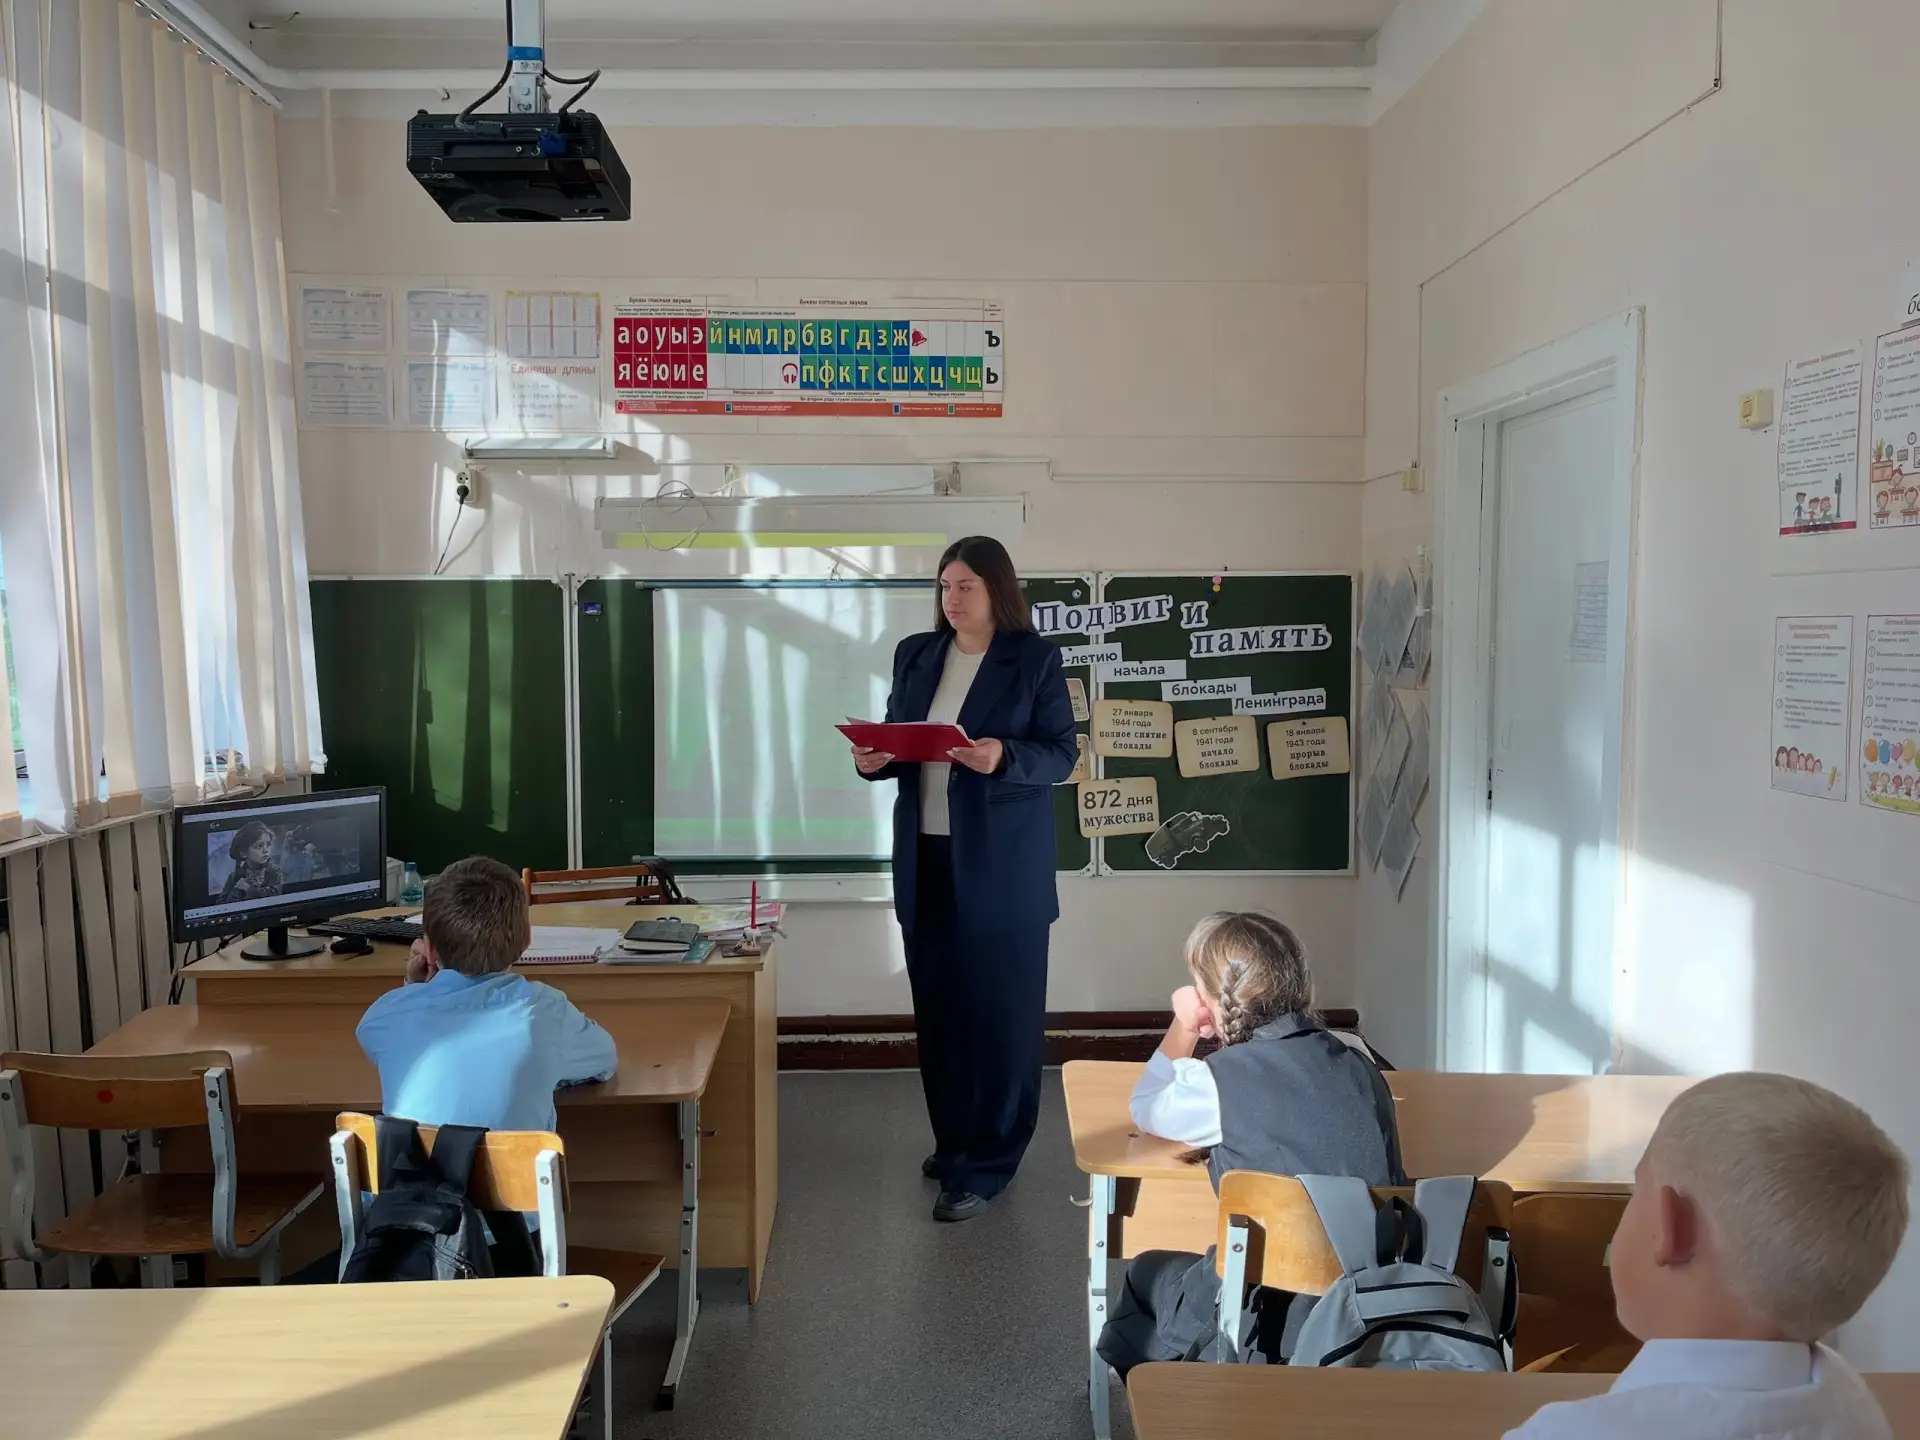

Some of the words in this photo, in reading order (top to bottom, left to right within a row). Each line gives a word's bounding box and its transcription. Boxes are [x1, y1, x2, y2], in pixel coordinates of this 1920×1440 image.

[618, 326, 630, 344] а
[636, 326, 649, 344] о
[654, 326, 666, 350] у
[671, 326, 688, 344] ы
[692, 326, 703, 344] э
[710, 320, 722, 344] й
[729, 328, 741, 344] н
[745, 328, 761, 344] м
[765, 328, 778, 344] л
[784, 328, 796, 351] р
[802, 321, 815, 346] б
[820, 329, 833, 345] в
[840, 329, 850, 345] г
[856, 329, 871, 350] д
[876, 329, 888, 346] з
[893, 329, 908, 346] ж
[511, 363, 557, 375] Единицы
[562, 365, 596, 376] длины
[618, 363, 630, 380] я
[637, 356, 648, 380] ё
[653, 363, 669, 381] ю
[673, 364, 685, 381] и
[692, 364, 704, 381] е
[802, 365, 814, 382] п
[818, 359, 835, 388] ф
[839, 365, 850, 382] к
[858, 366, 869, 382] т
[877, 365, 887, 383] с
[893, 366, 908, 383] ш
[913, 366, 925, 383] х
[930, 366, 944, 388] ц
[950, 366, 961, 383] ч
[966, 366, 982, 388] щ
[1036, 597, 1170, 632] Подвиг
[1183, 604, 1204, 624] и
[1193, 626, 1330, 654] память
[1114, 664, 1165, 677] начала
[1172, 682, 1236, 697] блокады
[1234, 692, 1324, 710] Ленинграда
[1200, 725, 1238, 734] сентября
[1113, 741, 1152, 750] блокады
[1286, 739, 1304, 748] 1943
[1201, 748, 1234, 757] начало
[1290, 750, 1326, 760] прорыв
[1199, 759, 1238, 769] блокады
[1290, 761, 1328, 770] блокады
[1083, 789, 1122, 810] 872
[1126, 794, 1153, 809] дня
[1083, 812, 1154, 830] мужества
